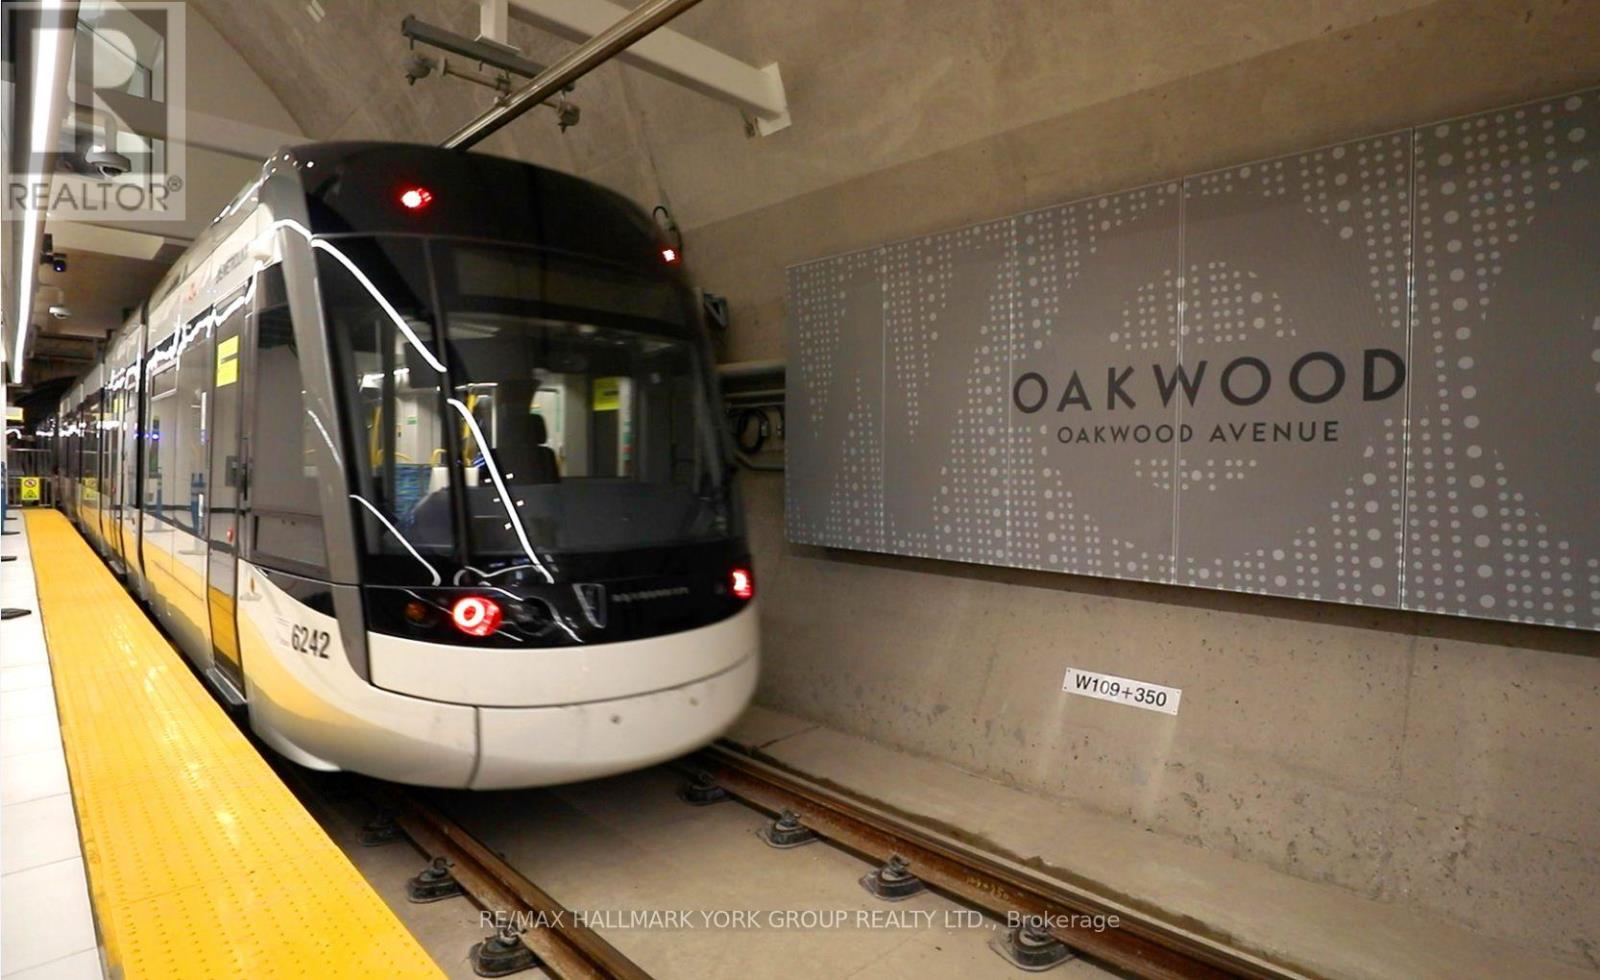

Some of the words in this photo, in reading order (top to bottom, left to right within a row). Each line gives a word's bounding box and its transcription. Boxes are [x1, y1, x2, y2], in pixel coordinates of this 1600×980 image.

[1013, 348, 1407, 414] OAKWOOD
[1057, 424, 1194, 444] OAKWOOD
[1209, 420, 1340, 443] AVENUE
[292, 624, 331, 659] 6242
[1075, 673, 1168, 707] W109+350
